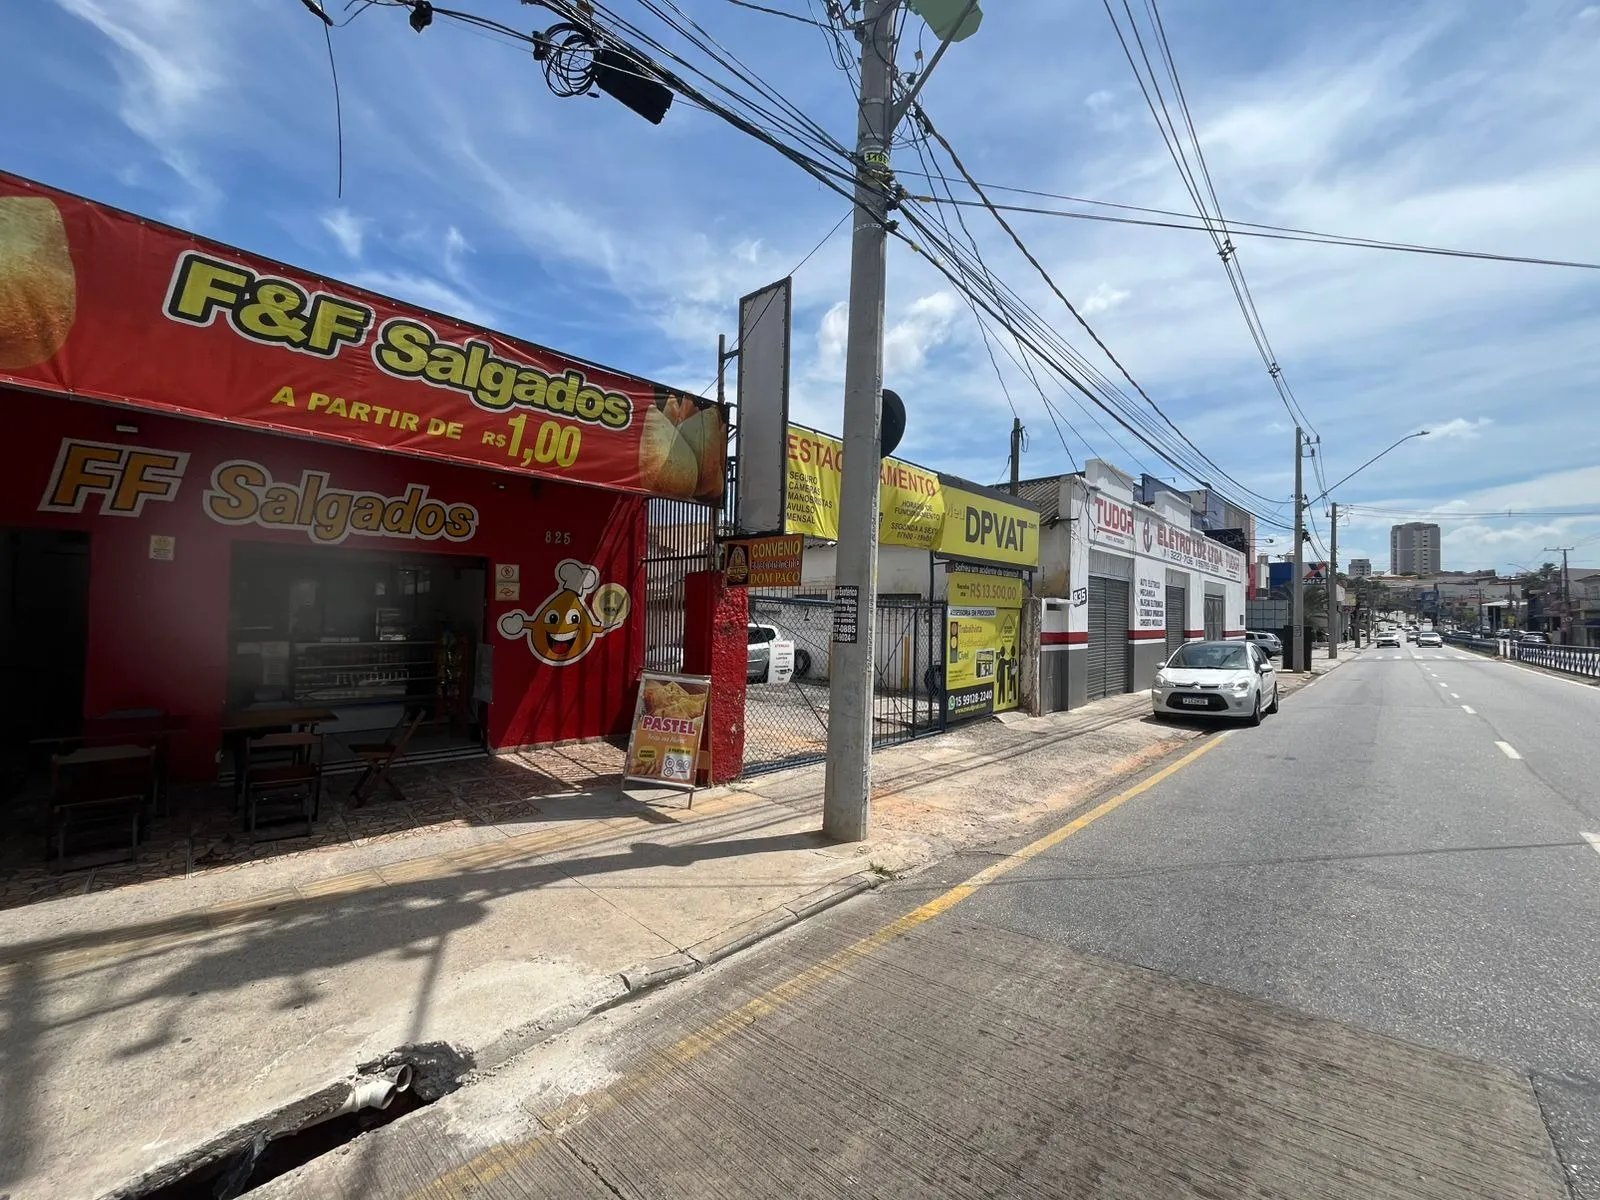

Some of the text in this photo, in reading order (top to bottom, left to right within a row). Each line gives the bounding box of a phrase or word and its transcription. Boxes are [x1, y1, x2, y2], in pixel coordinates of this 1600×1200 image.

[163, 250, 632, 431] F&F Salgados
[271, 386, 296, 407] A
[308, 392, 420, 432] PARTIR
[427, 418, 464, 441] DE
[507, 413, 582, 468] 1,00
[789, 471, 818, 485] SEGURO
[37, 437, 479, 544] FF Salgados
[787, 502, 816, 514] AVULSO
[1095, 496, 1135, 535] TUDOR
[787, 512, 816, 525] MENSAL
[965, 505, 1028, 552] DPVAT
[545, 531, 571, 545] 825
[752, 541, 800, 558] CONVENIO
[970, 583, 1017, 601] R$ 13.500,00
[956, 695, 962, 706] 15
[641, 715, 697, 735] PASTEL
